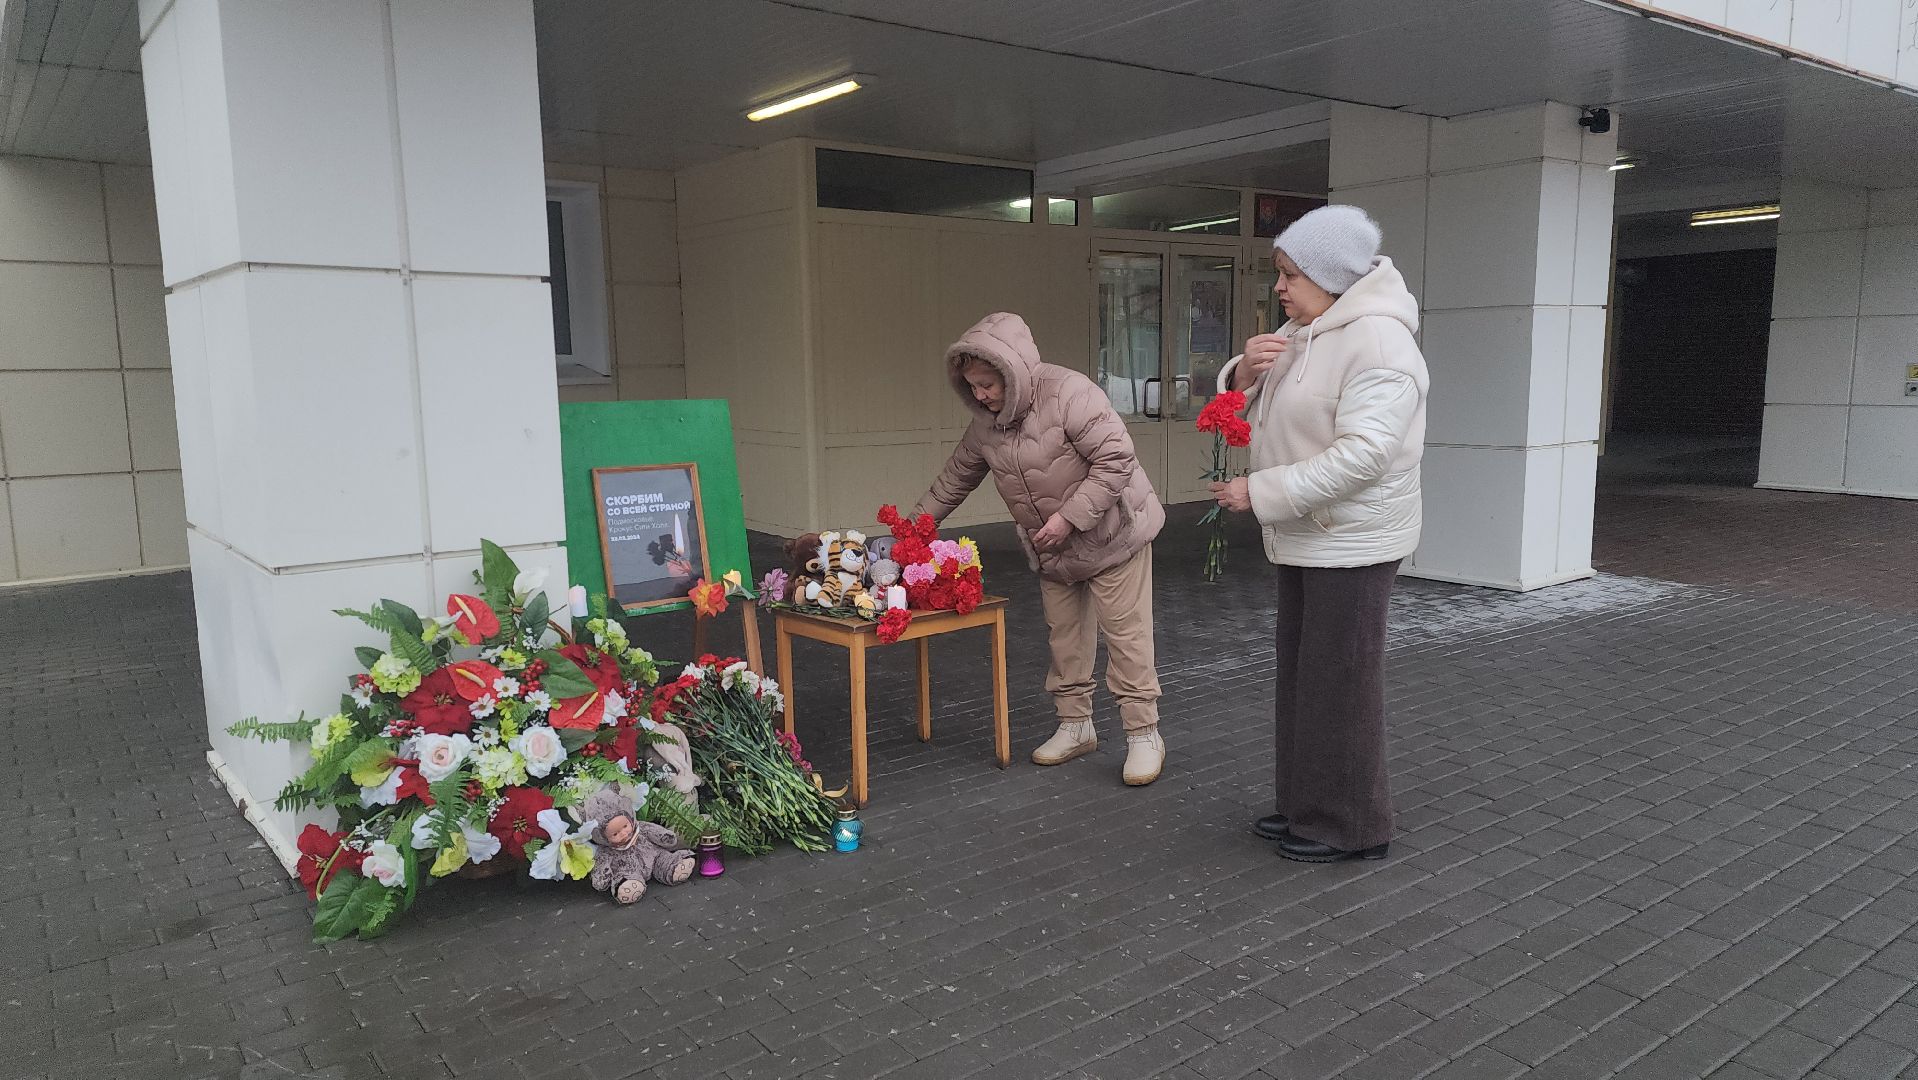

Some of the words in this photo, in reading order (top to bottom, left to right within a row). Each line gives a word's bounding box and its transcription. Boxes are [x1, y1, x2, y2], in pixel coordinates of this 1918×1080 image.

[605, 492, 664, 506] СКОРБИМ
[606, 507, 621, 516] СО
[622, 504, 648, 515] ВСЕЙ
[648, 500, 691, 513] СТРАНОЙ
